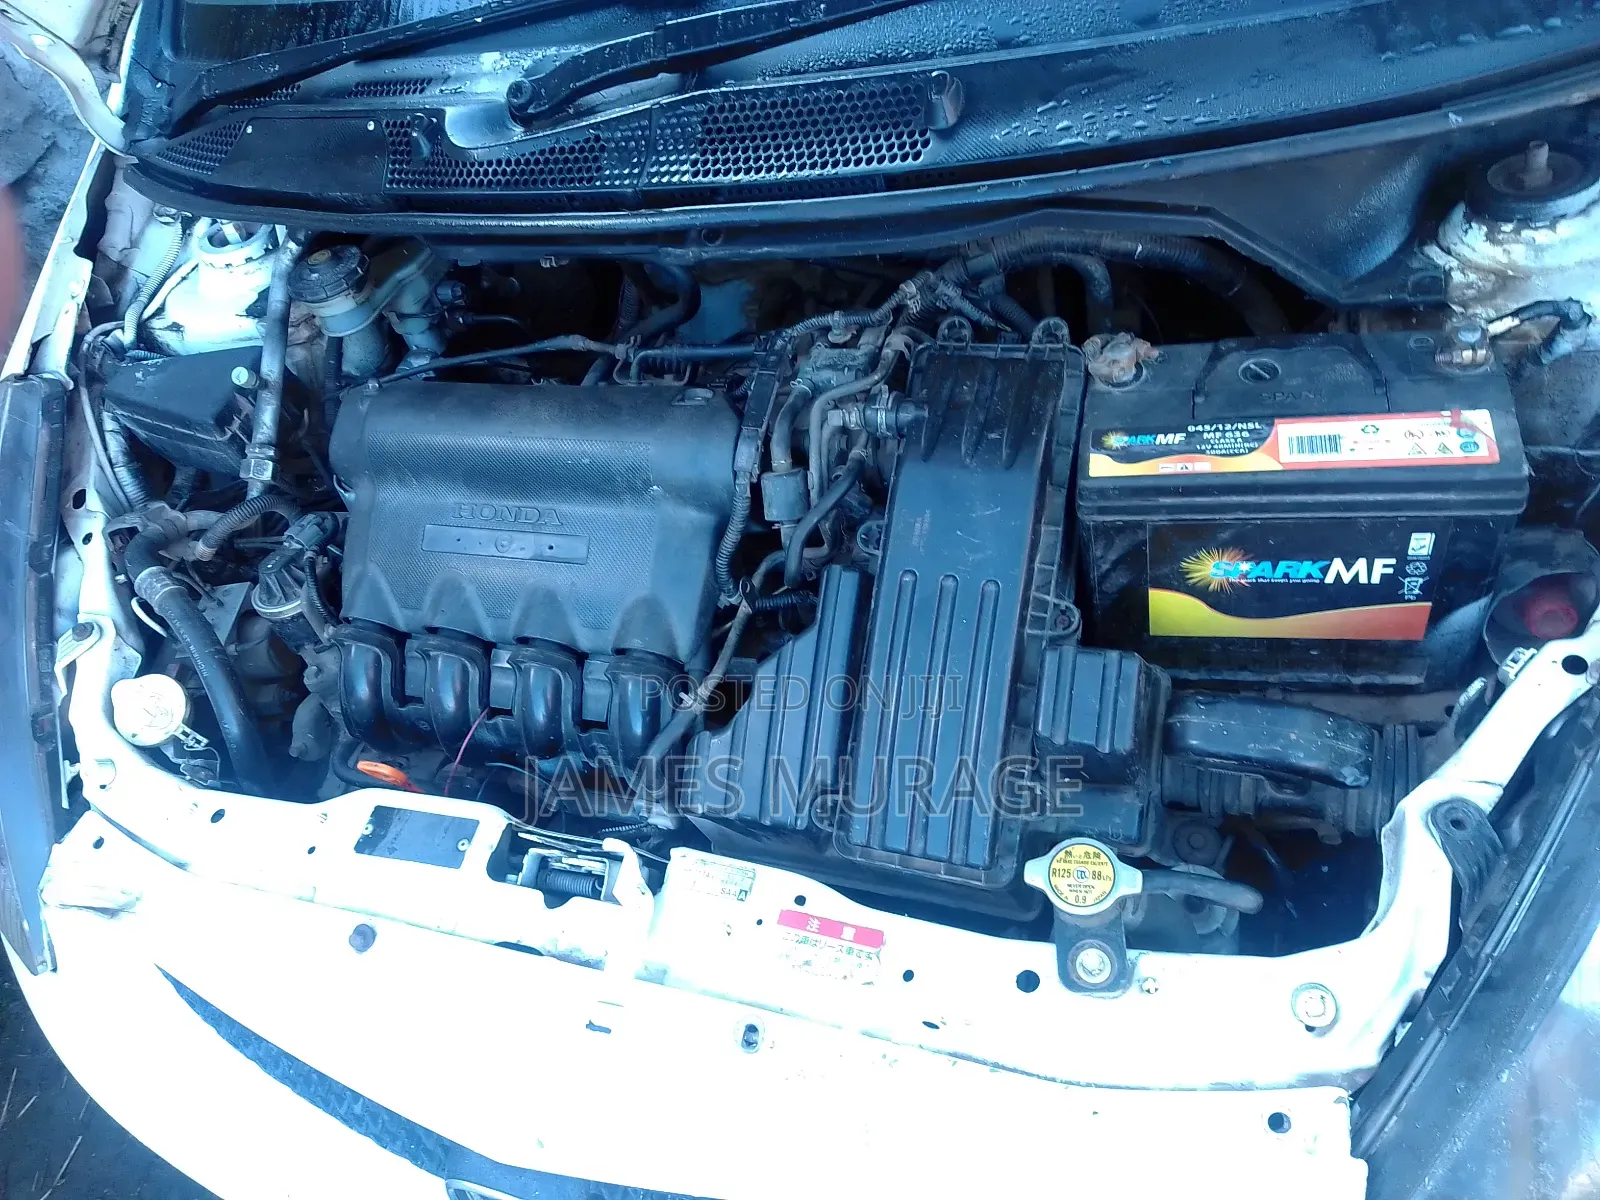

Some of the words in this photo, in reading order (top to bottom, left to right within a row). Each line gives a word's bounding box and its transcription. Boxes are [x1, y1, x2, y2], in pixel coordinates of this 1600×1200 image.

[1203, 432, 1222, 440] MF
[451, 501, 564, 526] HONDA
[1051, 868, 1072, 879] R125
[1074, 894, 1087, 904] 0.9
